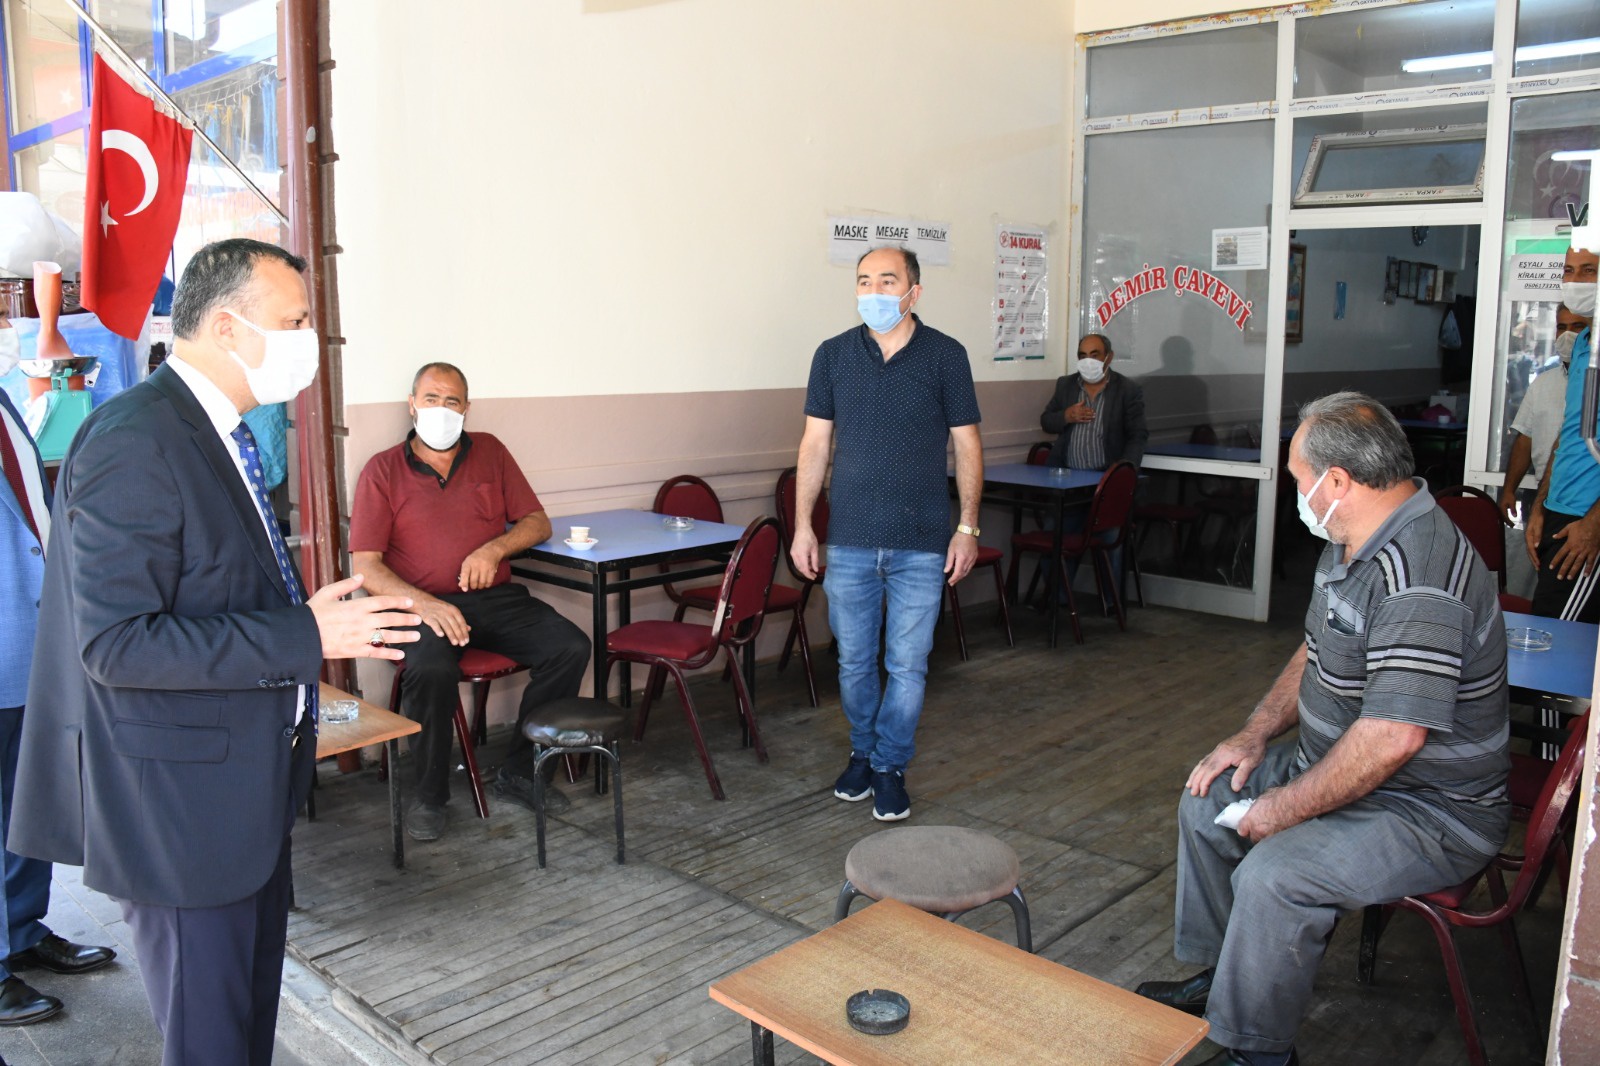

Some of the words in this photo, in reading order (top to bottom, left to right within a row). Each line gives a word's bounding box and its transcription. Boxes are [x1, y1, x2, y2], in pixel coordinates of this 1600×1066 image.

[834, 224, 868, 239] MASKE
[875, 225, 909, 239] MESAFE
[917, 227, 948, 240] TEMİZLİK
[1010, 235, 1018, 249] 14
[1019, 237, 1042, 250] KURAL
[1518, 261, 1543, 269] EŞYALI
[1548, 261, 1565, 269] SOB
[1517, 271, 1546, 279] KİRALIK
[1096, 262, 1168, 329] DEMİR
[1173, 264, 1253, 332] ÇAYEVİ
